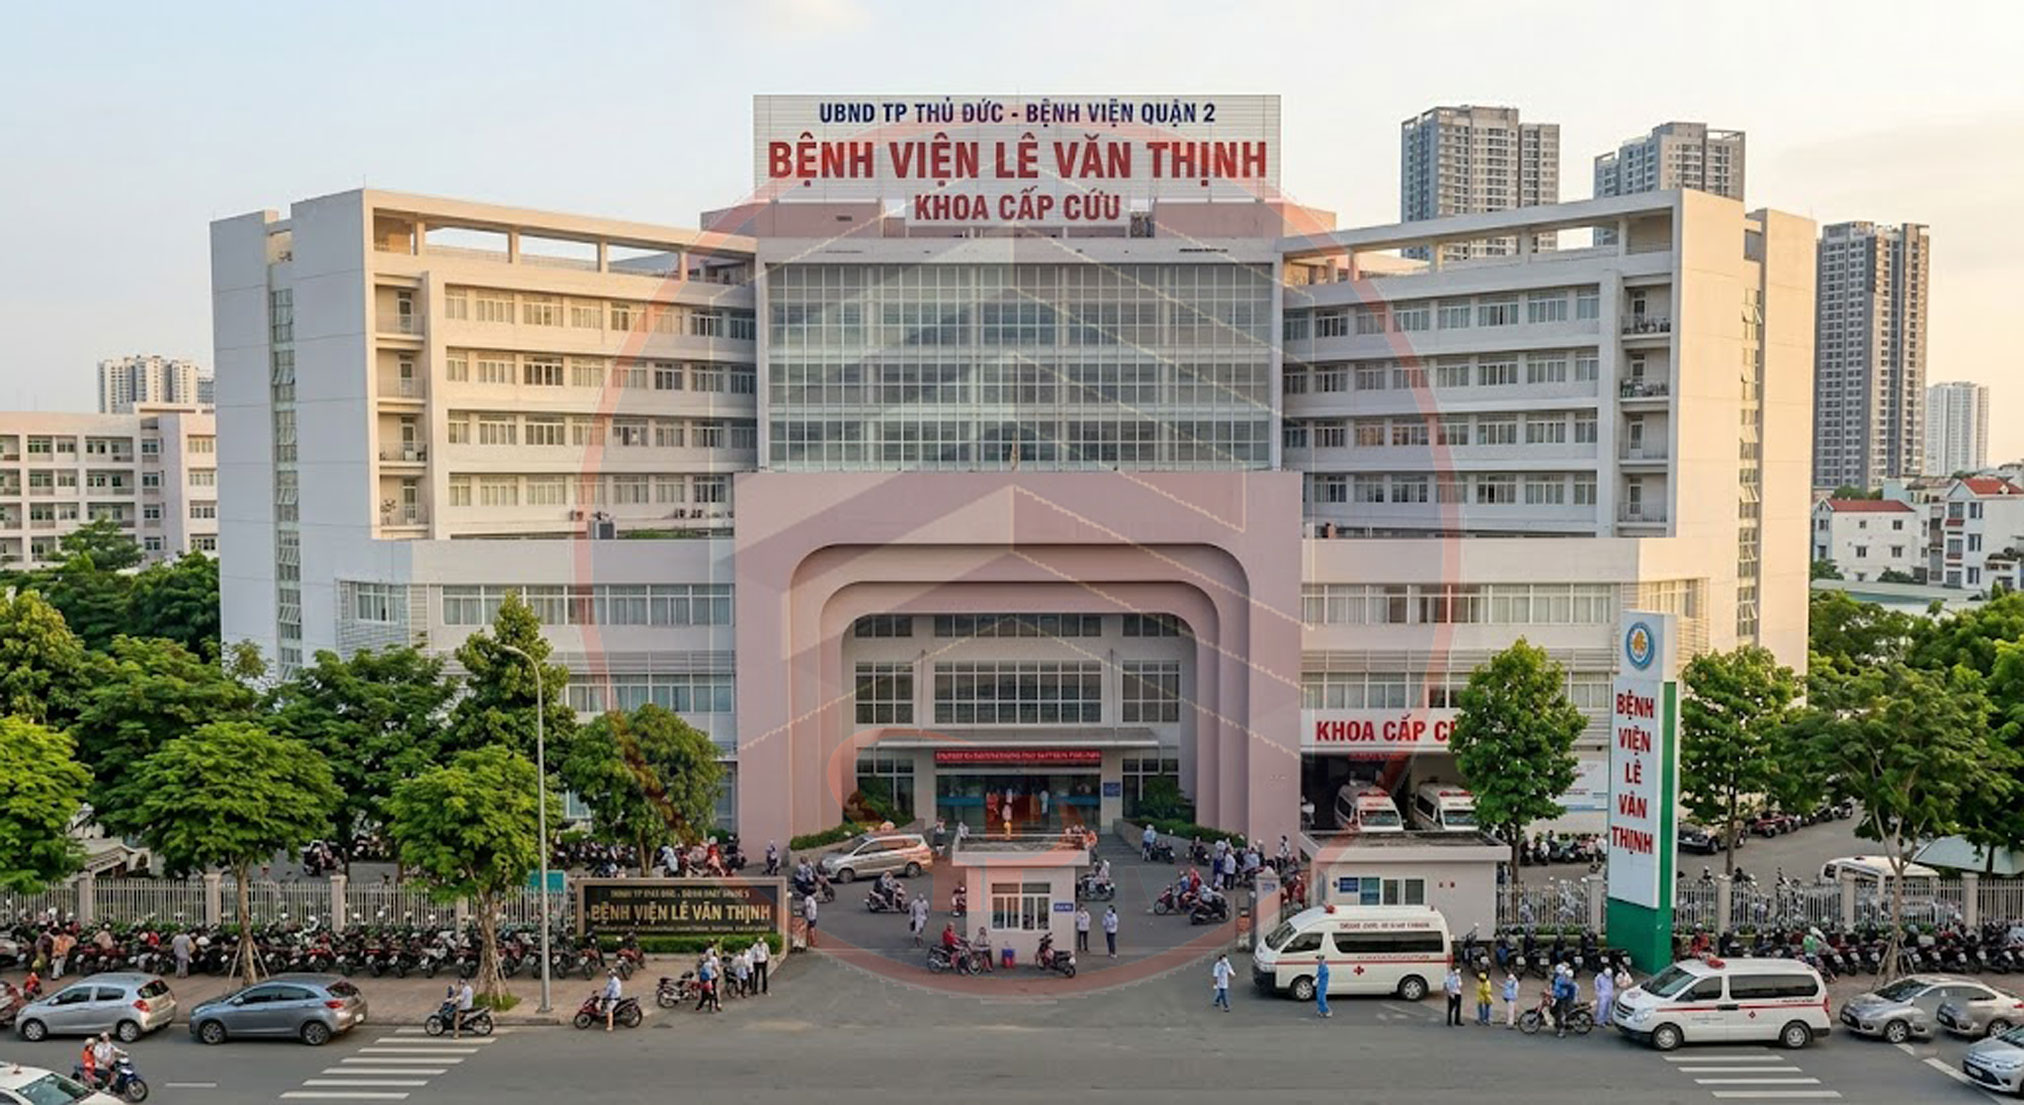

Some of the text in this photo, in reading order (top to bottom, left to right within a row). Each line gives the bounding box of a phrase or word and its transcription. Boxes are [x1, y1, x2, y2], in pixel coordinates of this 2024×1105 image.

[819, 103, 876, 123] UBND
[882, 103, 908, 123] TP
[914, 97, 954, 123] THỦ
[962, 99, 1004, 123] ĐỨC
[1027, 98, 1080, 127] BỆNH
[1088, 98, 1134, 127] VIỆN
[1142, 99, 1197, 127] QUẬN
[1204, 103, 1216, 123] 2
[769, 132, 1268, 187] BỆNH VIỆN LÊ VĂN THỊNH
[914, 186, 1121, 221] KHOA CẤP CỨU
[1616, 689, 1655, 721] BỆNH
[1316, 721, 1376, 741] KHOA
[1383, 713, 1427, 742] CẤP
[1618, 725, 1652, 756] VIỆN
[1611, 825, 1654, 855] THỊNH
[592, 901, 629, 925] BỆNH
[634, 901, 668, 924] VIỆN
[726, 905, 771, 925] THỊNH
